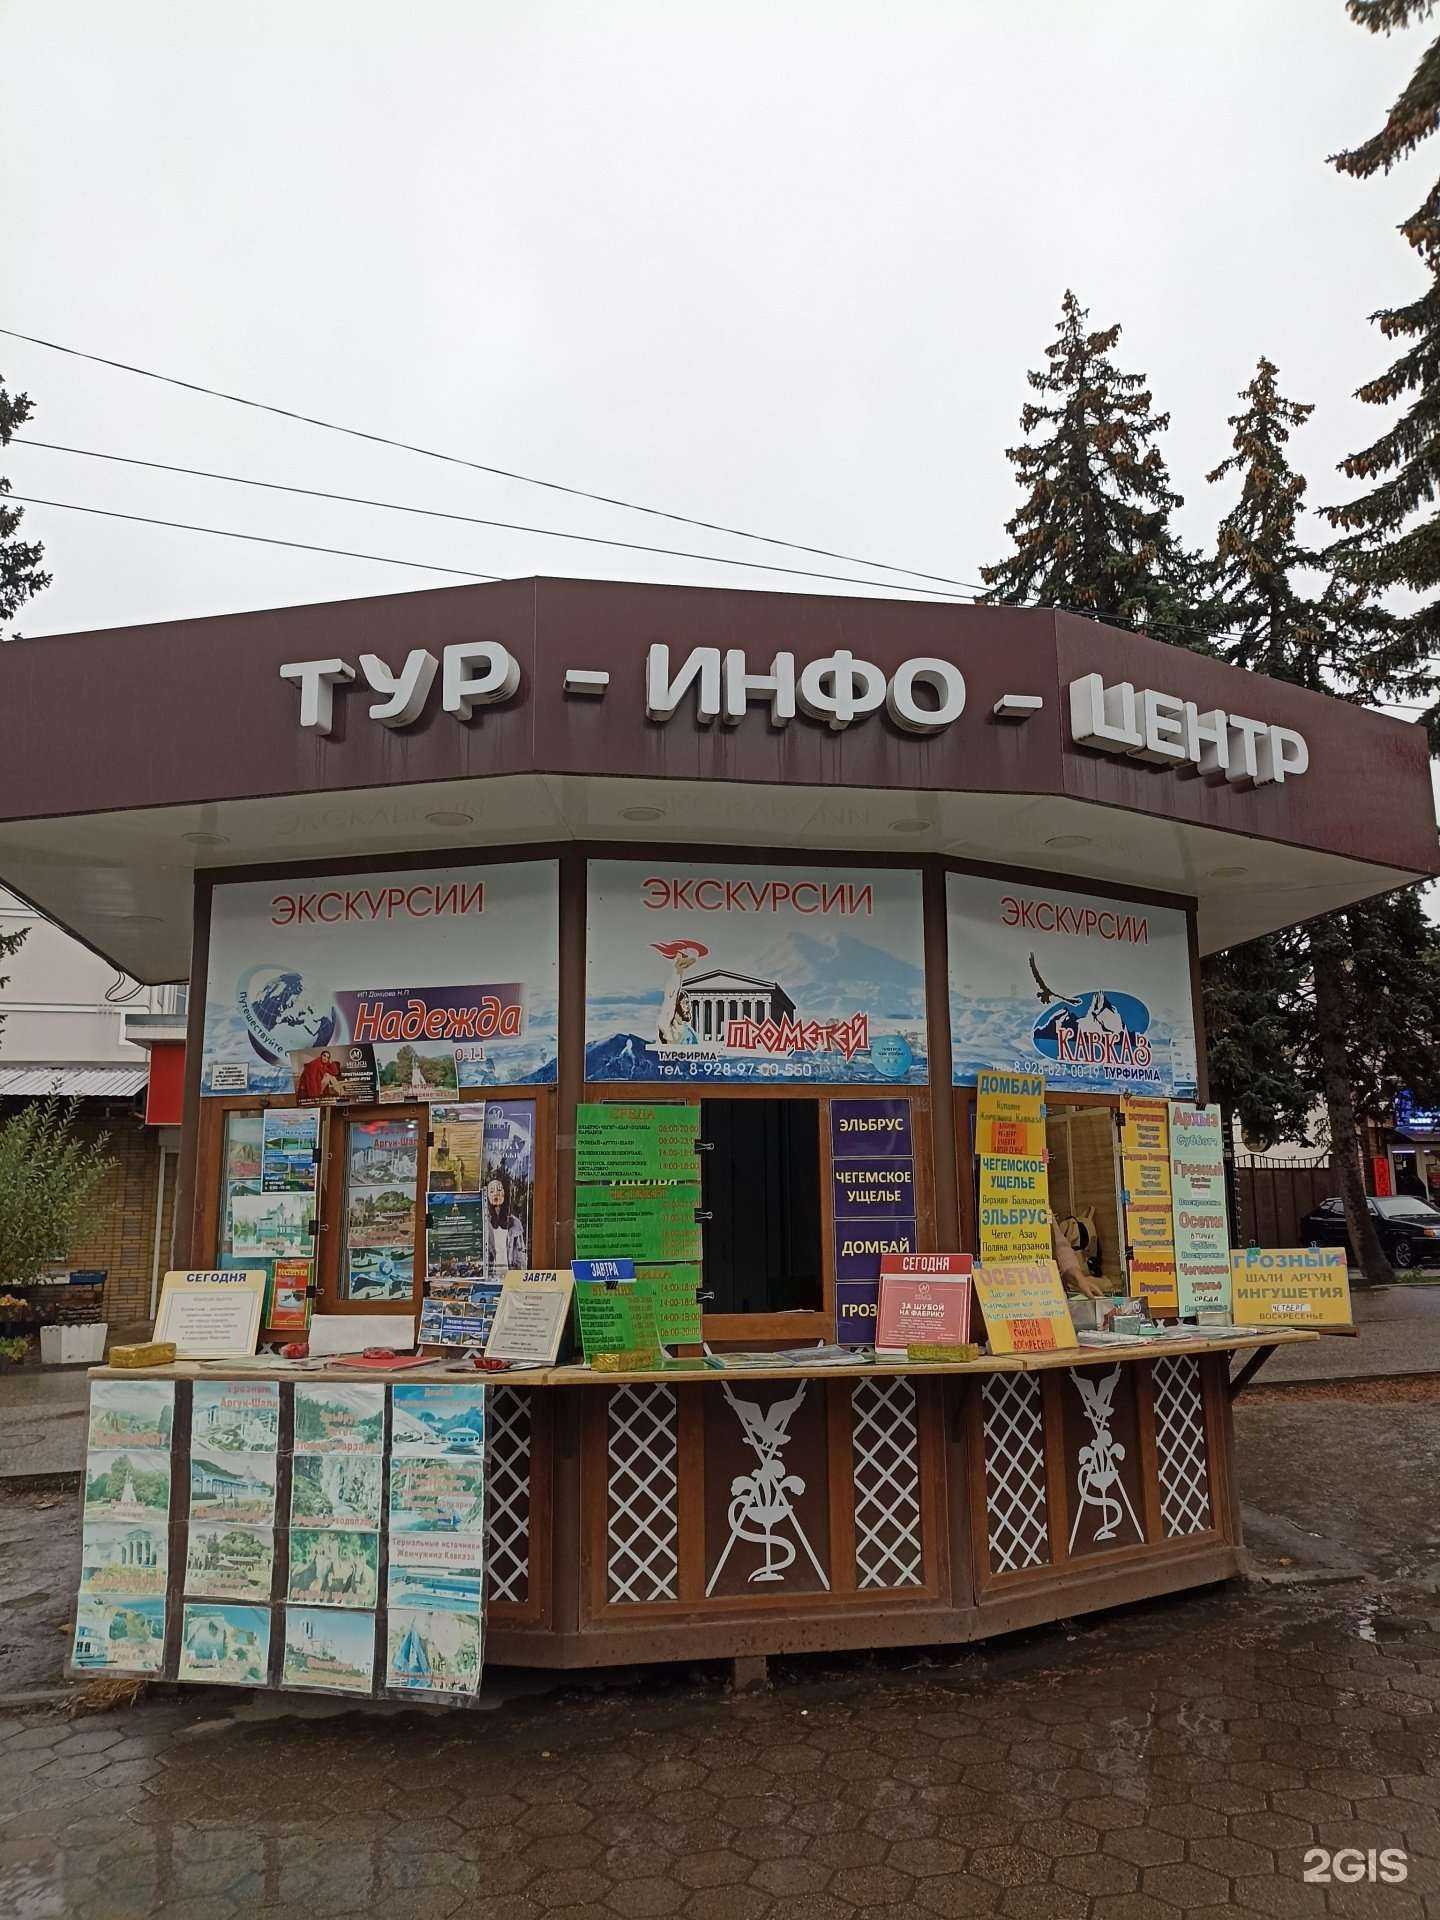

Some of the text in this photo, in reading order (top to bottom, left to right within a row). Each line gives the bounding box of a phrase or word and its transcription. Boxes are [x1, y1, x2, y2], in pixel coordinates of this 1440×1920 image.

[280, 641, 520, 733] ТУР
[646, 643, 966, 733] ИНФО
[1070, 673, 1309, 784] ЦЕНТР
[271, 881, 486, 926] ЭКСКУРСИИ
[642, 877, 874, 915] ЭКСКУРСИИ
[1000, 897, 1148, 944] ЭКСКУРСИИ
[239, 991, 283, 1052] Путешествуйте
[353, 995, 522, 1041] Надежда
[726, 1010, 870, 1062] ПРОМЕТЕЙ
[1056, 1026, 1151, 1066] КАВКАЗ
[658, 1050, 718, 1062] ТУРФИРМА
[1104, 1066, 1161, 1082] ТУРФИРМА
[979, 1074, 1042, 1097] ДОМБАЙ
[839, 1118, 904, 1131] ЭЛЬБРУС
[982, 1156, 1045, 1173] ЧЕГЕМСКОЕ
[836, 1171, 912, 1184] ЧЕГЕМСКОЕ
[990, 1175, 1036, 1190] УЩЕЛЬЕ
[847, 1190, 902, 1204] УЩЕЛЬЕ
[982, 1208, 1047, 1226] ЭЛЬБРУС
[841, 1238, 910, 1256] ДОМБАЙ
[591, 1261, 619, 1277] ЗАВТРА
[902, 1256, 950, 1272] СЕГОДНЯ
[186, 1273, 247, 1283] СЕГОДНЯ
[522, 1272, 557, 1283] ЗАВТРА
[1246, 1272, 1332, 1282] ШАЛИ АРГУН
[1237, 1287, 1343, 1299] ИНГУШЕТИЯ
[913, 1303, 944, 1311] ШУБОЙ
[1259, 1312, 1324, 1320] ВОСКРЕСЕНЬЕ
